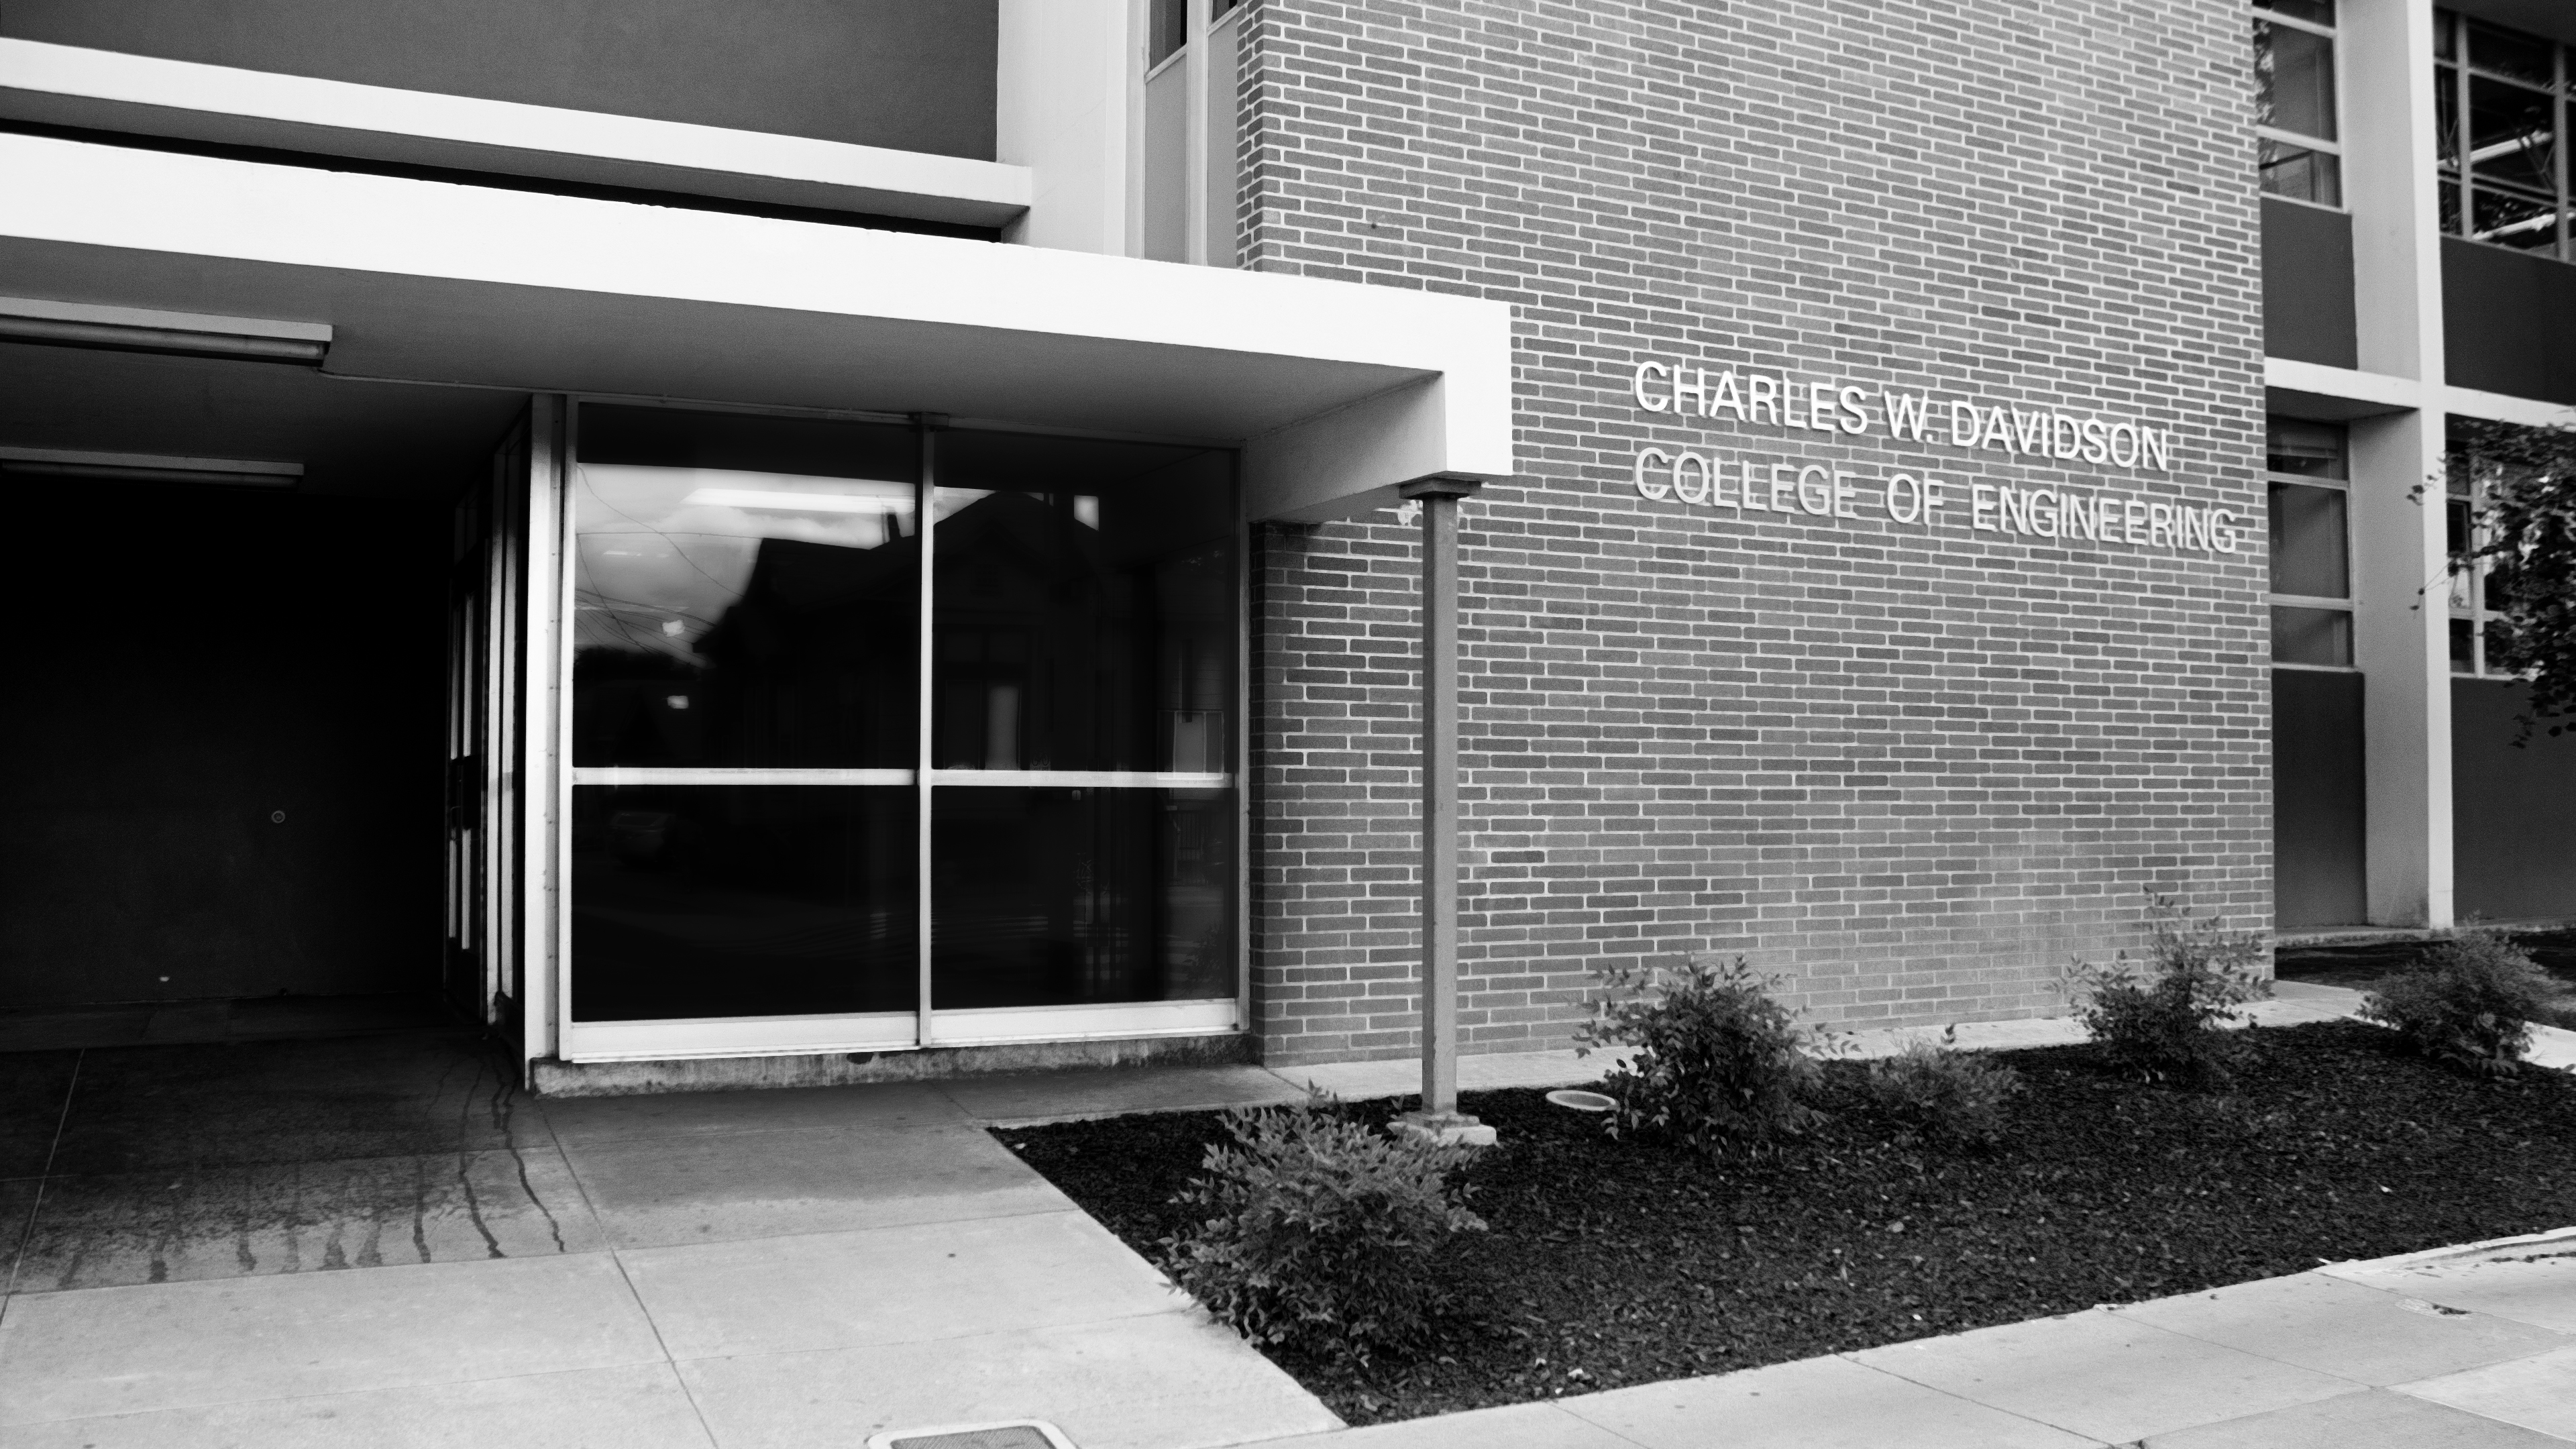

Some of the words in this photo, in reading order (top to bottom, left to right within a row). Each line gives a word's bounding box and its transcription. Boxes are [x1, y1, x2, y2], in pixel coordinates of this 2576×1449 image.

[1635, 361, 1868, 435] CHARLES
[1885, 390, 1933, 443] W.
[1951, 400, 2167, 471] DAVIDSON
[1634, 447, 1856, 518] COLLEGE
[1886, 473, 1944, 525] OF
[1972, 484, 2237, 553] ENGINEERING
